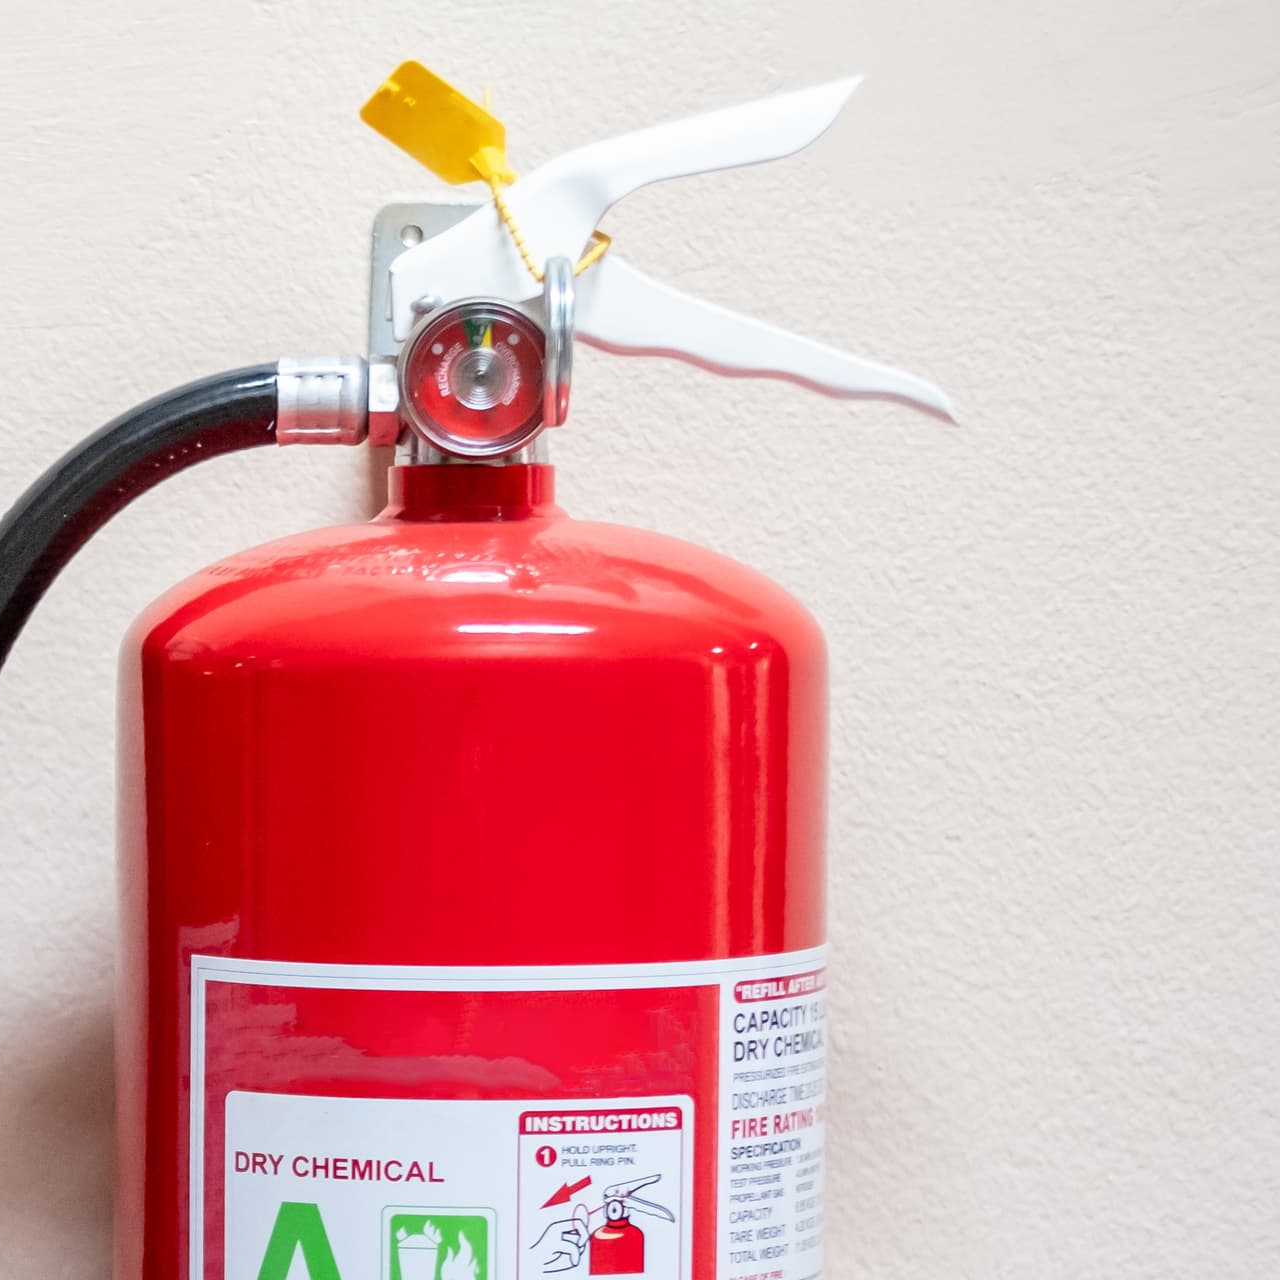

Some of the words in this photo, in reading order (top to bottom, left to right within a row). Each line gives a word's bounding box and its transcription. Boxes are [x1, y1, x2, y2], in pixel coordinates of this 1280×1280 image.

[734, 1006, 807, 1033] CAPACITY
[733, 1039, 769, 1062] DRY
[525, 1112, 678, 1132] INSTRUCTIONS
[732, 1116, 768, 1139] FIRE
[773, 1107, 814, 1135] RATING
[540, 1149, 550, 1165] 1
[561, 1146, 589, 1154] HOLD
[234, 1151, 285, 1175] DRY
[291, 1155, 445, 1183] CHEMICAL
[561, 1159, 587, 1167] PULL
[590, 1158, 615, 1166] RING
